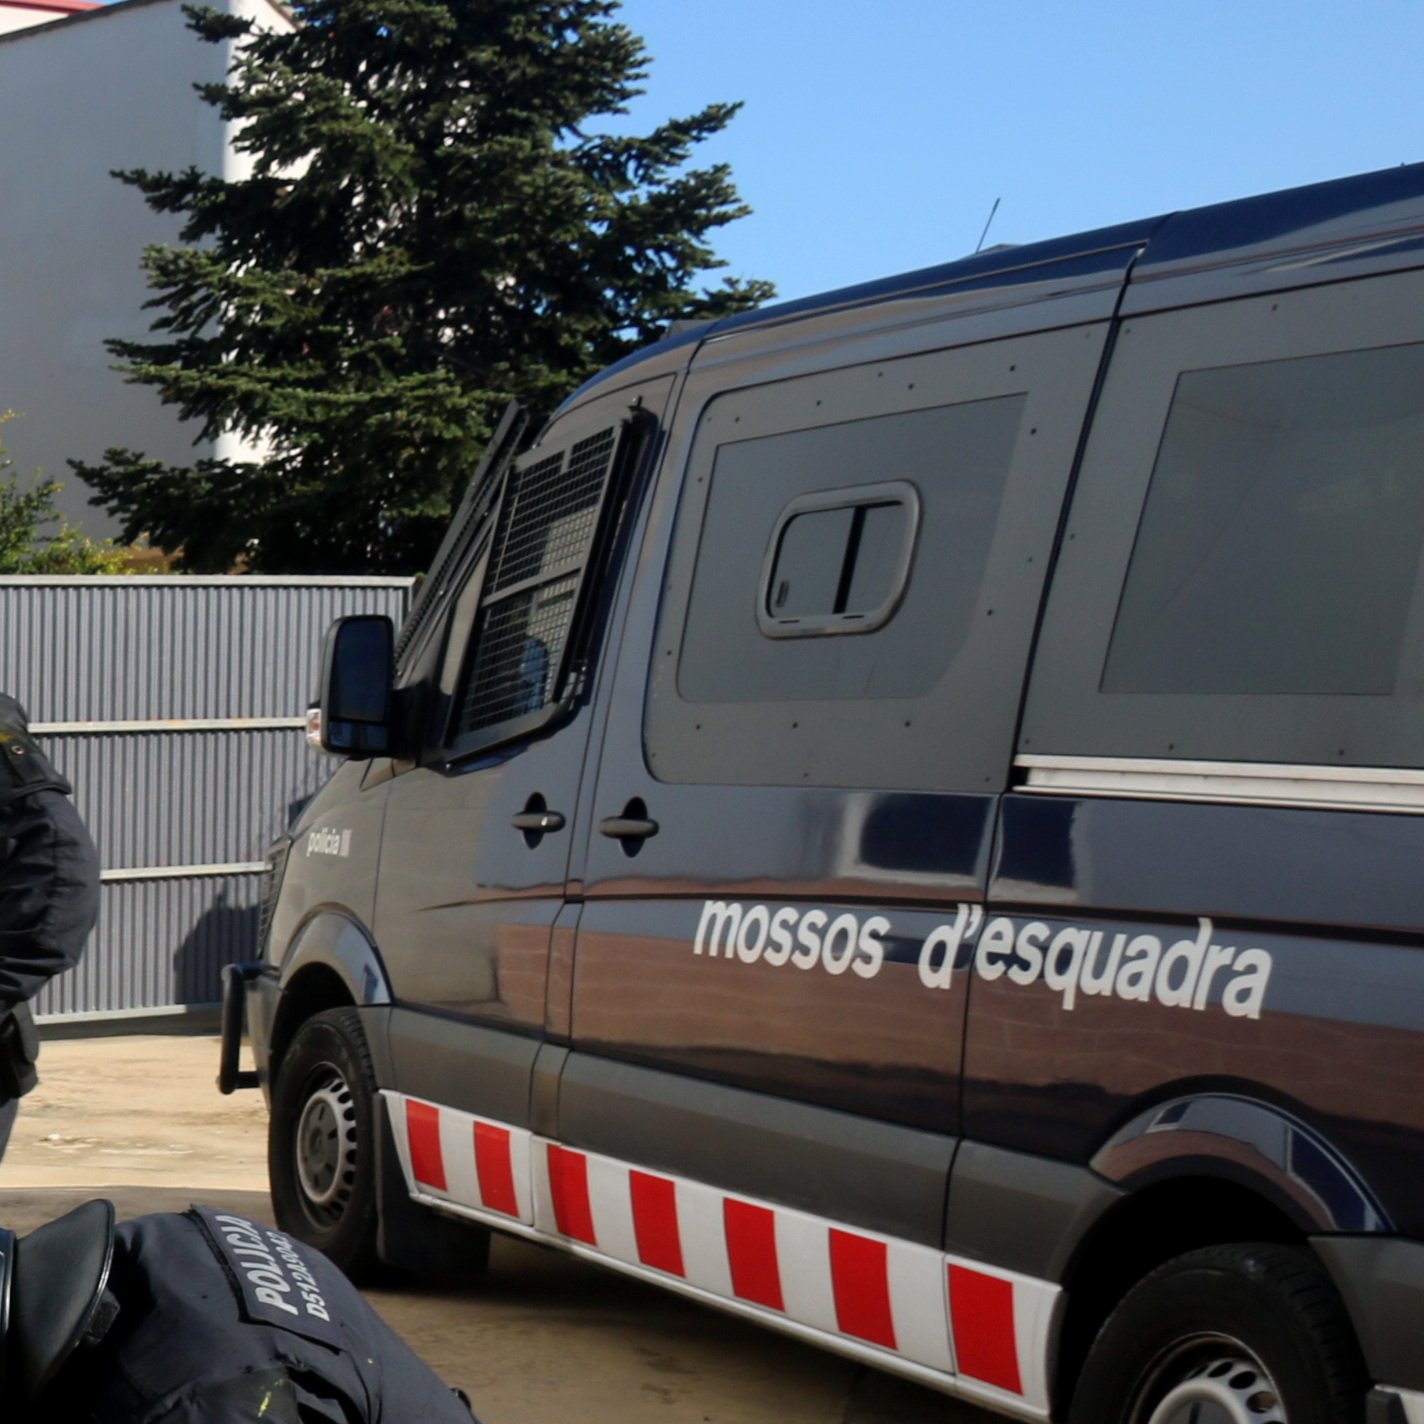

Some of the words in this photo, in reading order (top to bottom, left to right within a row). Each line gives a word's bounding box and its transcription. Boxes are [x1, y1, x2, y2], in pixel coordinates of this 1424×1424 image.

[306, 827, 340, 857] policia
[693, 900, 892, 979] mossos
[918, 903, 1274, 1020] d'esquadra
[215, 1215, 298, 1315] POLICIA
